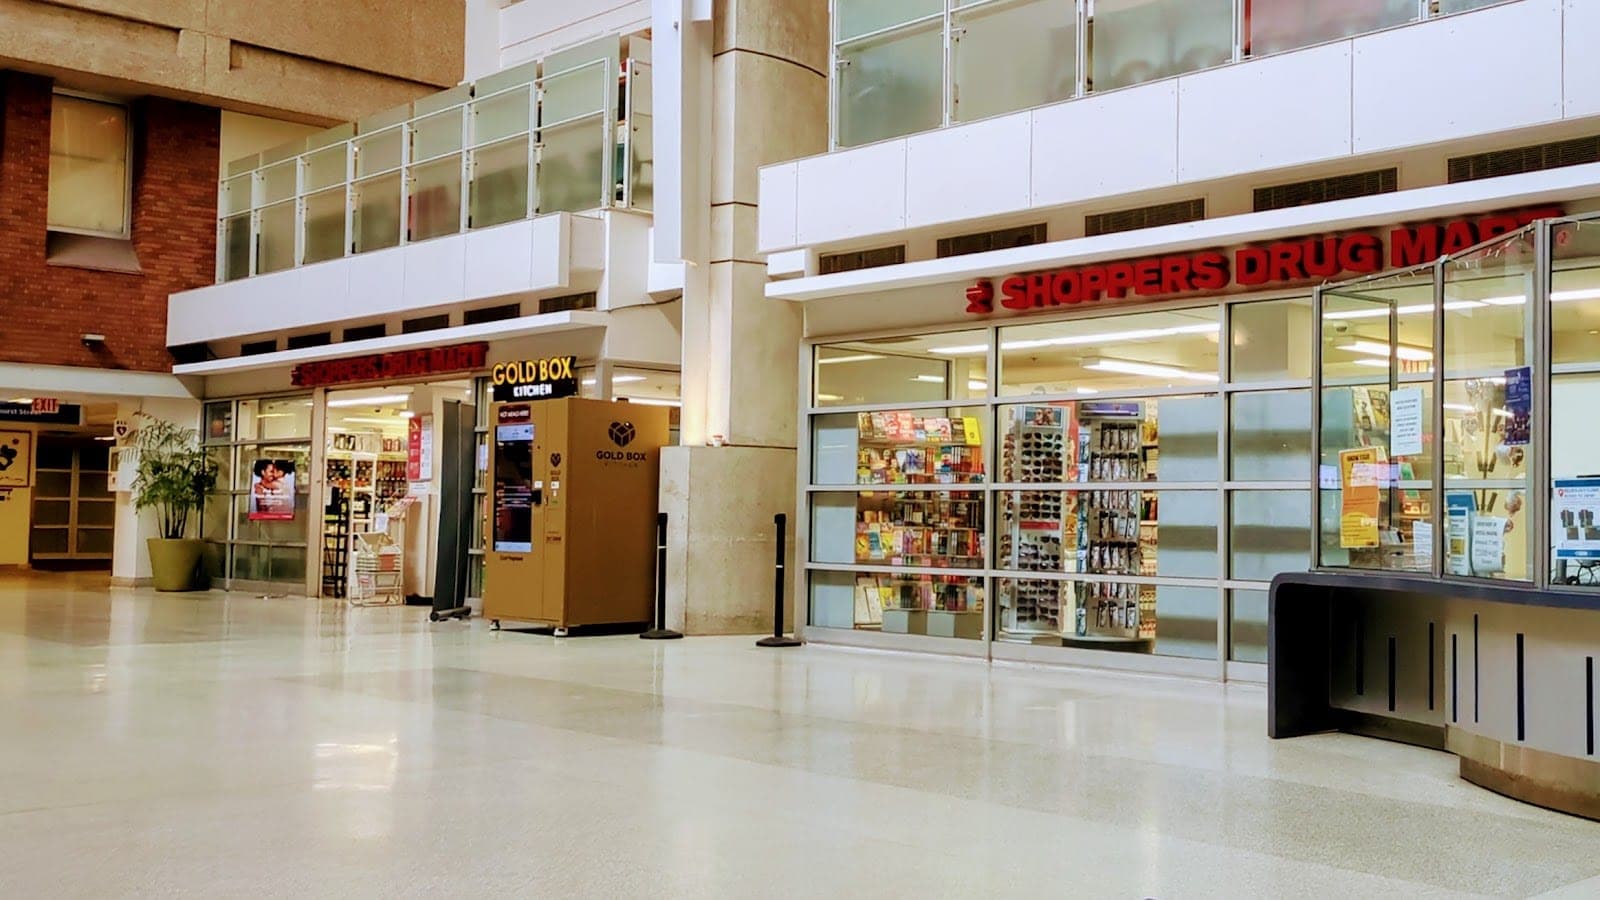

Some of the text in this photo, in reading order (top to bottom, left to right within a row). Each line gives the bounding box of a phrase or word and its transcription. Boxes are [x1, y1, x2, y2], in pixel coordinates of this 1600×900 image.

[1001, 252, 1231, 309] SHOPPERS
[1236, 231, 1384, 286] DRUG
[493, 356, 573, 385] GOLD BOX
[513, 383, 552, 397] KITCHEN
[33, 397, 58, 412] EXIT
[596, 450, 647, 461] GOLD BOX
